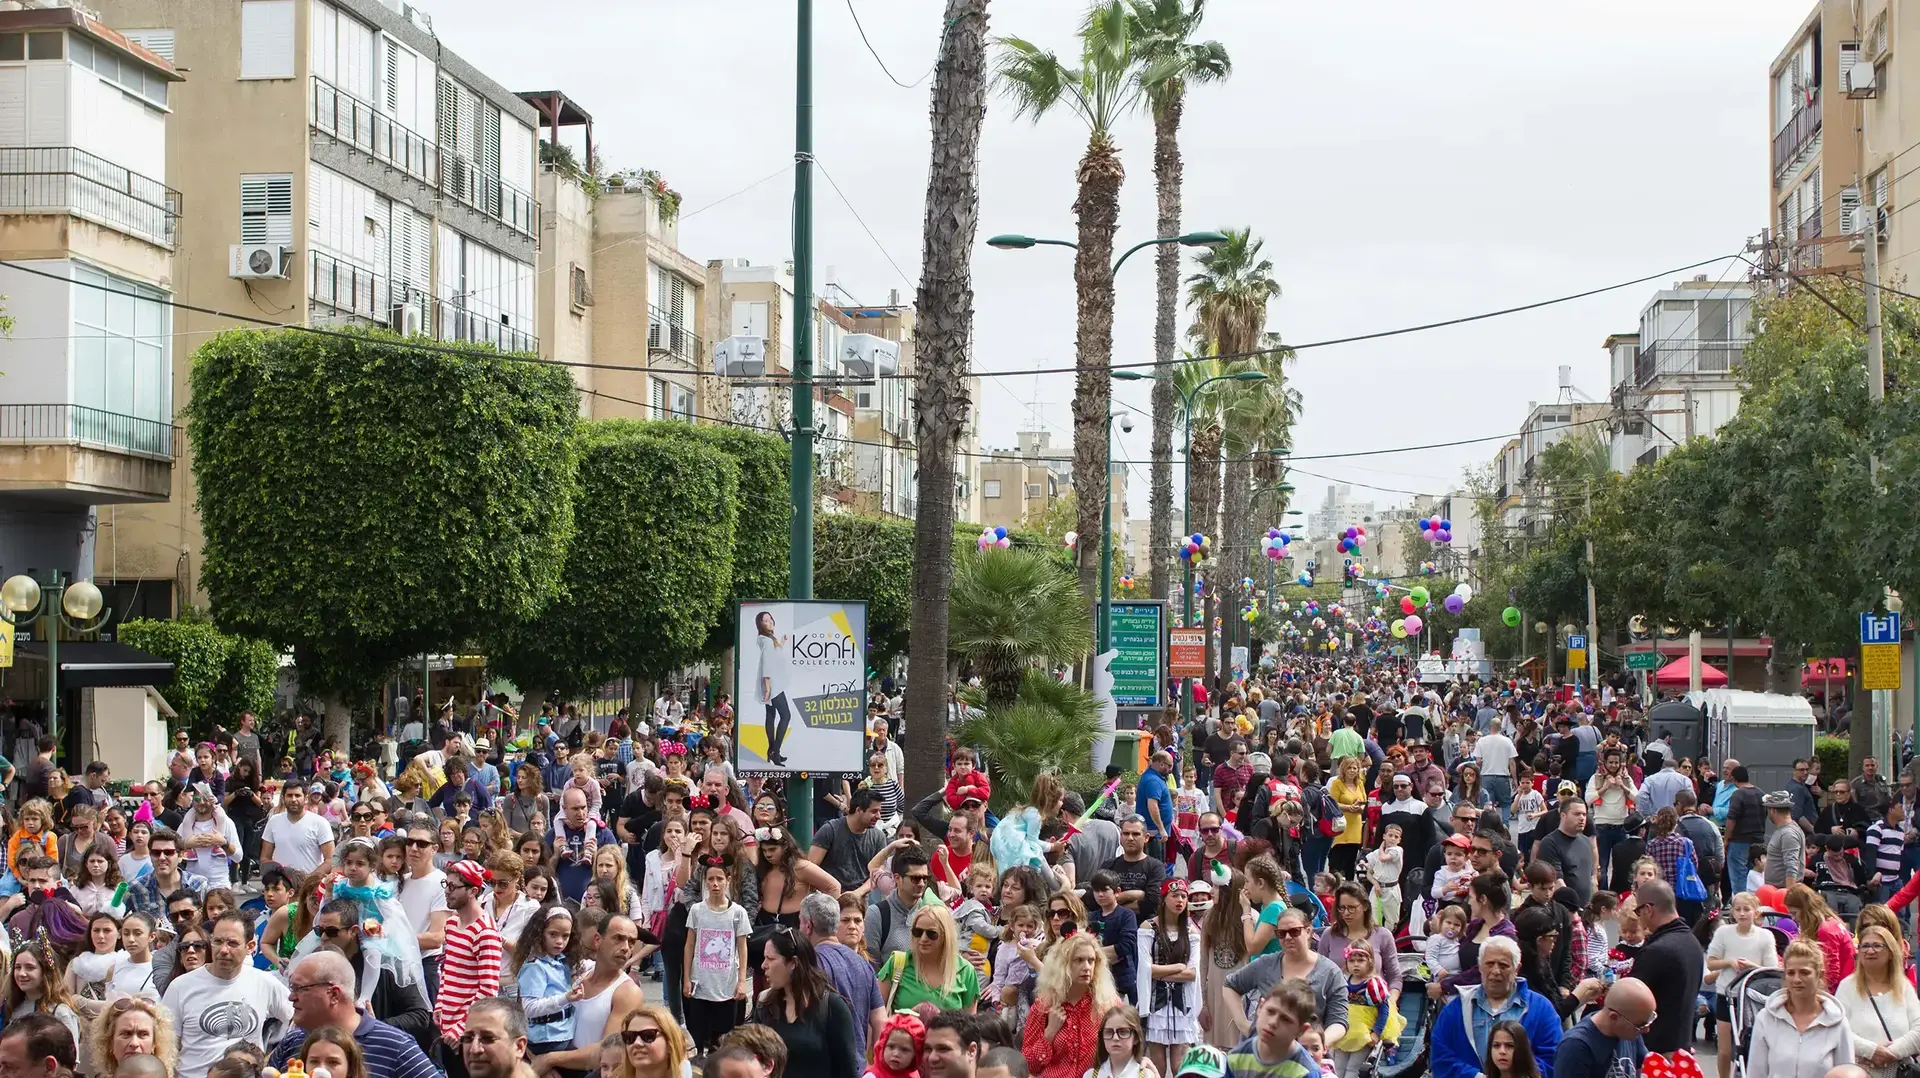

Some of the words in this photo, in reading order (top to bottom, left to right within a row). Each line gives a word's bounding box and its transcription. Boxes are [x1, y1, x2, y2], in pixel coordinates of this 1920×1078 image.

[792, 634, 855, 659] Konfi
[1629, 654, 1646, 662] לכיש
[822, 679, 857, 698] עברנו
[804, 700, 818, 712] 32
[819, 696, 859, 714] כצנלסון
[811, 713, 854, 726] גבעתיים
[739, 771, 792, 779] 03-7415356
[842, 772, 863, 780] 02-A
